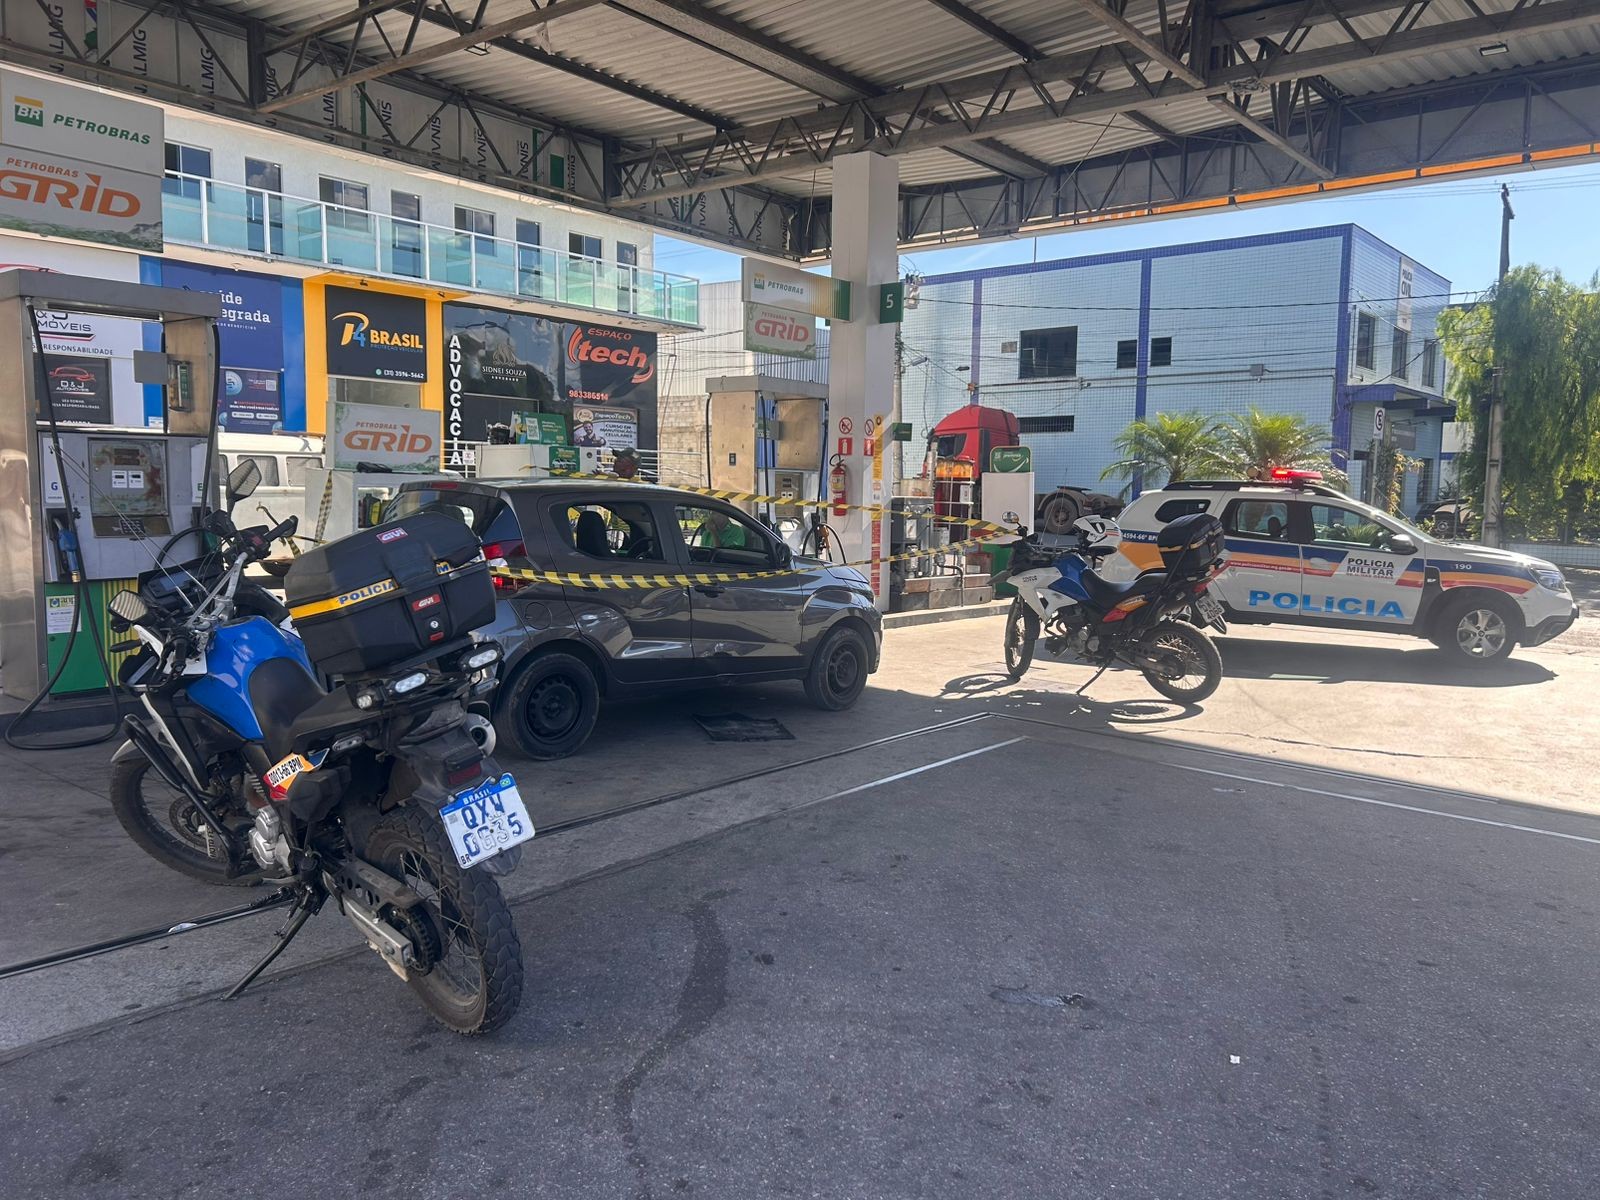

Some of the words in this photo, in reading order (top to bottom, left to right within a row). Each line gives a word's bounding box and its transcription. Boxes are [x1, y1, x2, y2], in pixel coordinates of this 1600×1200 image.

[17, 105, 42, 121] BR
[53, 113, 151, 146] PETROBRAS
[6, 157, 79, 178] PETROBRAS
[0, 171, 140, 218] GRID
[767, 281, 804, 295] PETROBRAS
[886, 293, 895, 309] 5
[587, 328, 632, 341] ESPAÇO
[754, 317, 809, 342] GRID
[370, 329, 424, 349] BRASIL
[43, 344, 113, 356] RESPONSABILIDADE
[578, 340, 647, 368] tech
[482, 366, 504, 374] SIDNEI
[505, 368, 527, 377] SOUZA
[449, 334, 463, 465] ADVOCACIA
[355, 421, 397, 431] PETROBRAS
[343, 424, 432, 454] GRID
[381, 529, 405, 541] GIVI
[1346, 566, 1393, 577] MILITAR
[418, 597, 434, 607] GIVI
[463, 788, 493, 805] BRASIL
[460, 853, 472, 865] BR
